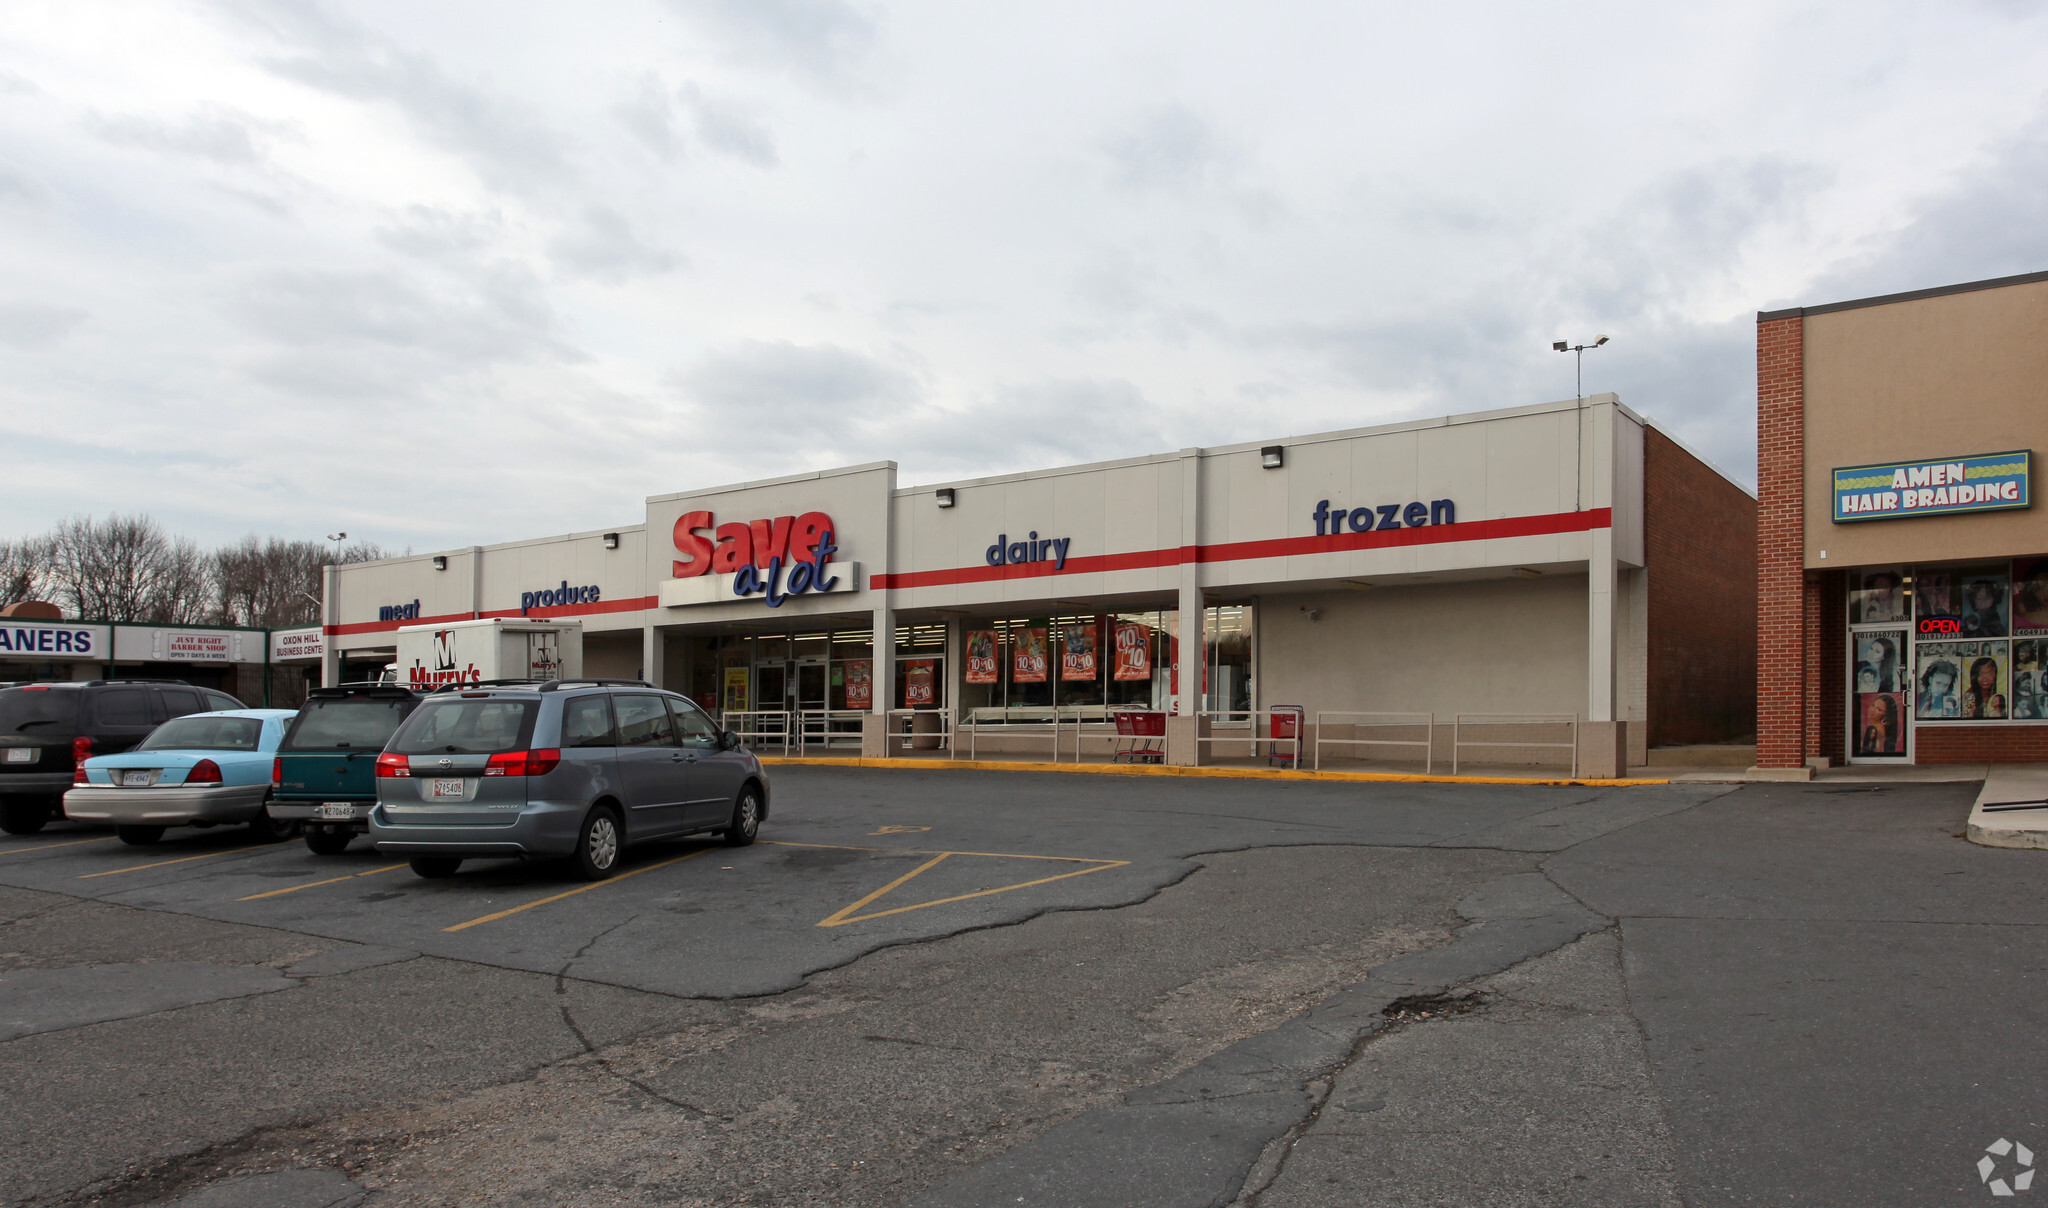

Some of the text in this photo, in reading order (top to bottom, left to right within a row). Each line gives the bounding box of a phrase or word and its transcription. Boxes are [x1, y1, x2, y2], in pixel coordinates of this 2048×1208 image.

[1892, 462, 1965, 489] AMEN
[1842, 481, 2020, 514] HAIR BRAIDING
[1313, 499, 1454, 536] frozen
[672, 510, 836, 579] Save
[986, 530, 1070, 570] dairy
[521, 580, 600, 616] produce
[379, 599, 420, 621] meat
[1920, 619, 1960, 633] OPEN
[0, 628, 91, 652] ANERS
[171, 643, 204, 651] BARBER
[282, 633, 320, 646] OXON HILL
[1120, 629, 1136, 650] 10
[276, 646, 303, 657] BUSINESS
[1066, 654, 1077, 667] 10
[970, 658, 980, 670] 10
[1017, 656, 1028, 669] 10
[410, 659, 480, 690] Murry's
[848, 685, 856, 697] 10
[908, 686, 917, 697] 10
